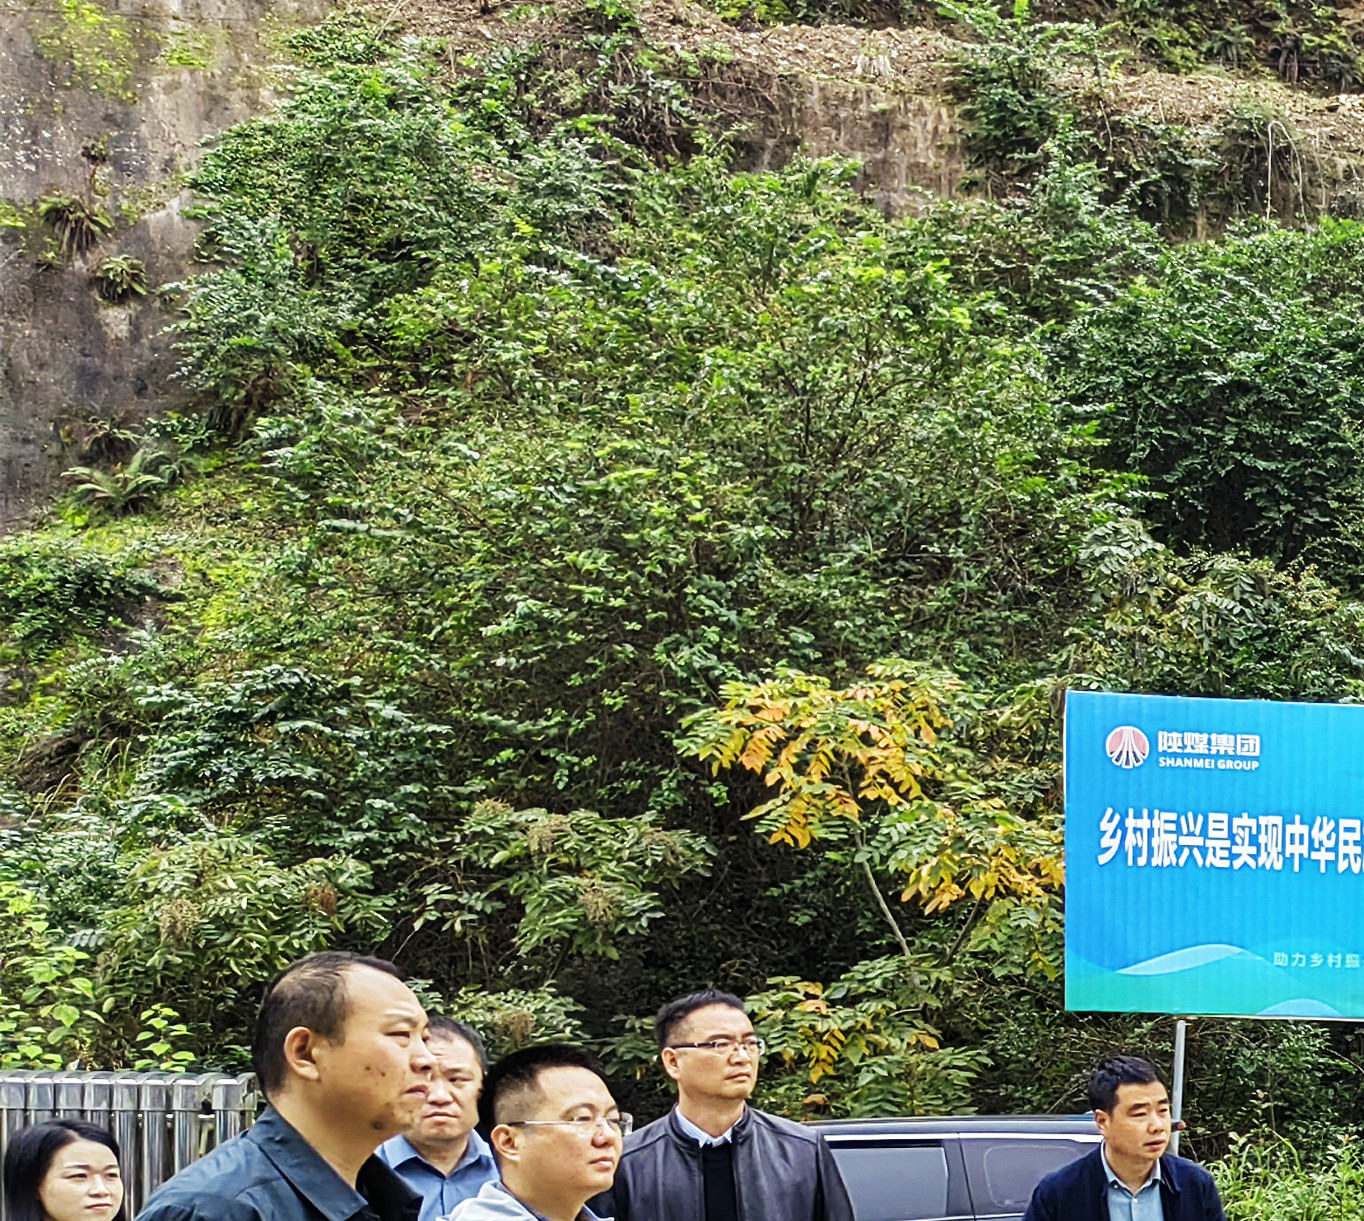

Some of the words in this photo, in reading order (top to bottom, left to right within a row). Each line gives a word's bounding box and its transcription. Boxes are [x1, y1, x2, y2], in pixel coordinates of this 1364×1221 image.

[1158, 731, 1261, 756] 陕煤集团
[1159, 757, 1215, 769] SHANMEI
[1217, 759, 1259, 771] GROUP
